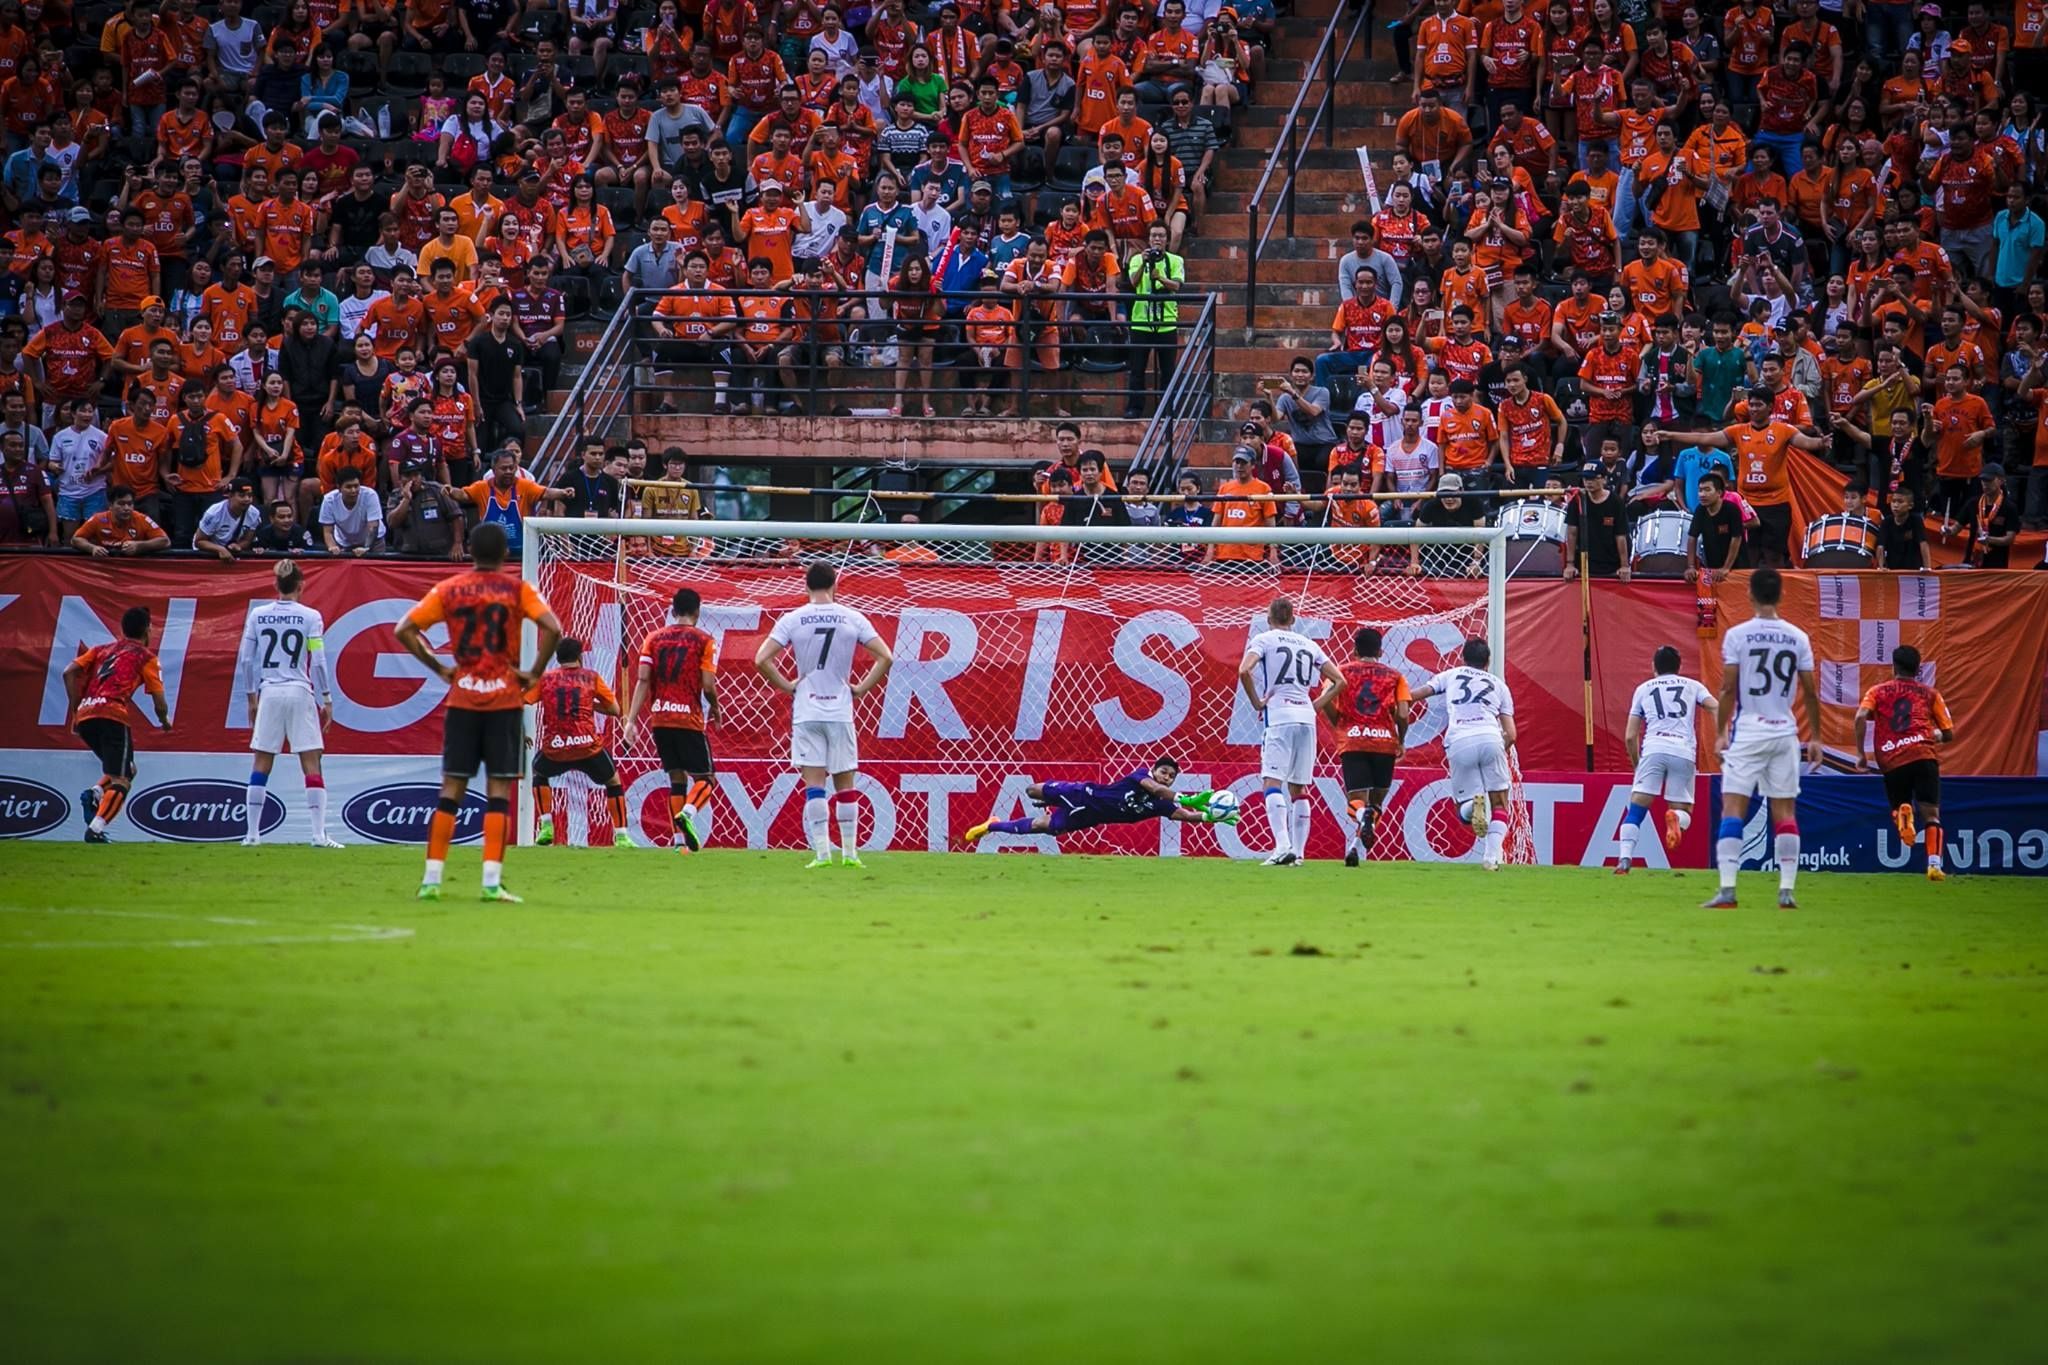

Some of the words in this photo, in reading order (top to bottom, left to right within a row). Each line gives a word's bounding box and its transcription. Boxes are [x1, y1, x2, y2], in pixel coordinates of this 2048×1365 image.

[1433, 53, 1452, 64] LEO
[1087, 88, 1105, 100] LEO
[1629, 147, 1648, 157] LEO
[154, 221, 175, 233] LEO
[1638, 292, 1657, 303] LEO
[436, 321, 456, 333] LEO
[686, 323, 705, 334] LEO
[220, 331, 239, 342] LEO
[387, 328, 409, 340] LEO
[124, 452, 147, 464] LEO
[1745, 473, 1767, 484] LEO
[1227, 508, 1246, 519] LEO
[257, 614, 304, 626] DECHMITR
[800, 614, 848, 626] BOSKOVIC
[453, 602, 509, 658] 28
[261, 628, 304, 670] 29
[813, 626, 837, 671] 7
[657, 645, 689, 686] 17
[1274, 645, 1314, 687] 20
[1747, 647, 1798, 698] 39
[1450, 674, 1496, 707] 32
[555, 686, 582, 721] 11
[1355, 680, 1379, 715] 6
[1649, 686, 1689, 721] 13
[661, 700, 691, 714] AQUA
[1890, 697, 1913, 732] 8
[1362, 726, 1392, 739] AQUA
[565, 734, 594, 746] AQUA
[1895, 734, 1925, 748] AQUA
[151, 795, 248, 822] Carrie
[548, 770, 1061, 855] TOYOTA
[1799, 855, 1850, 872] ngkok
